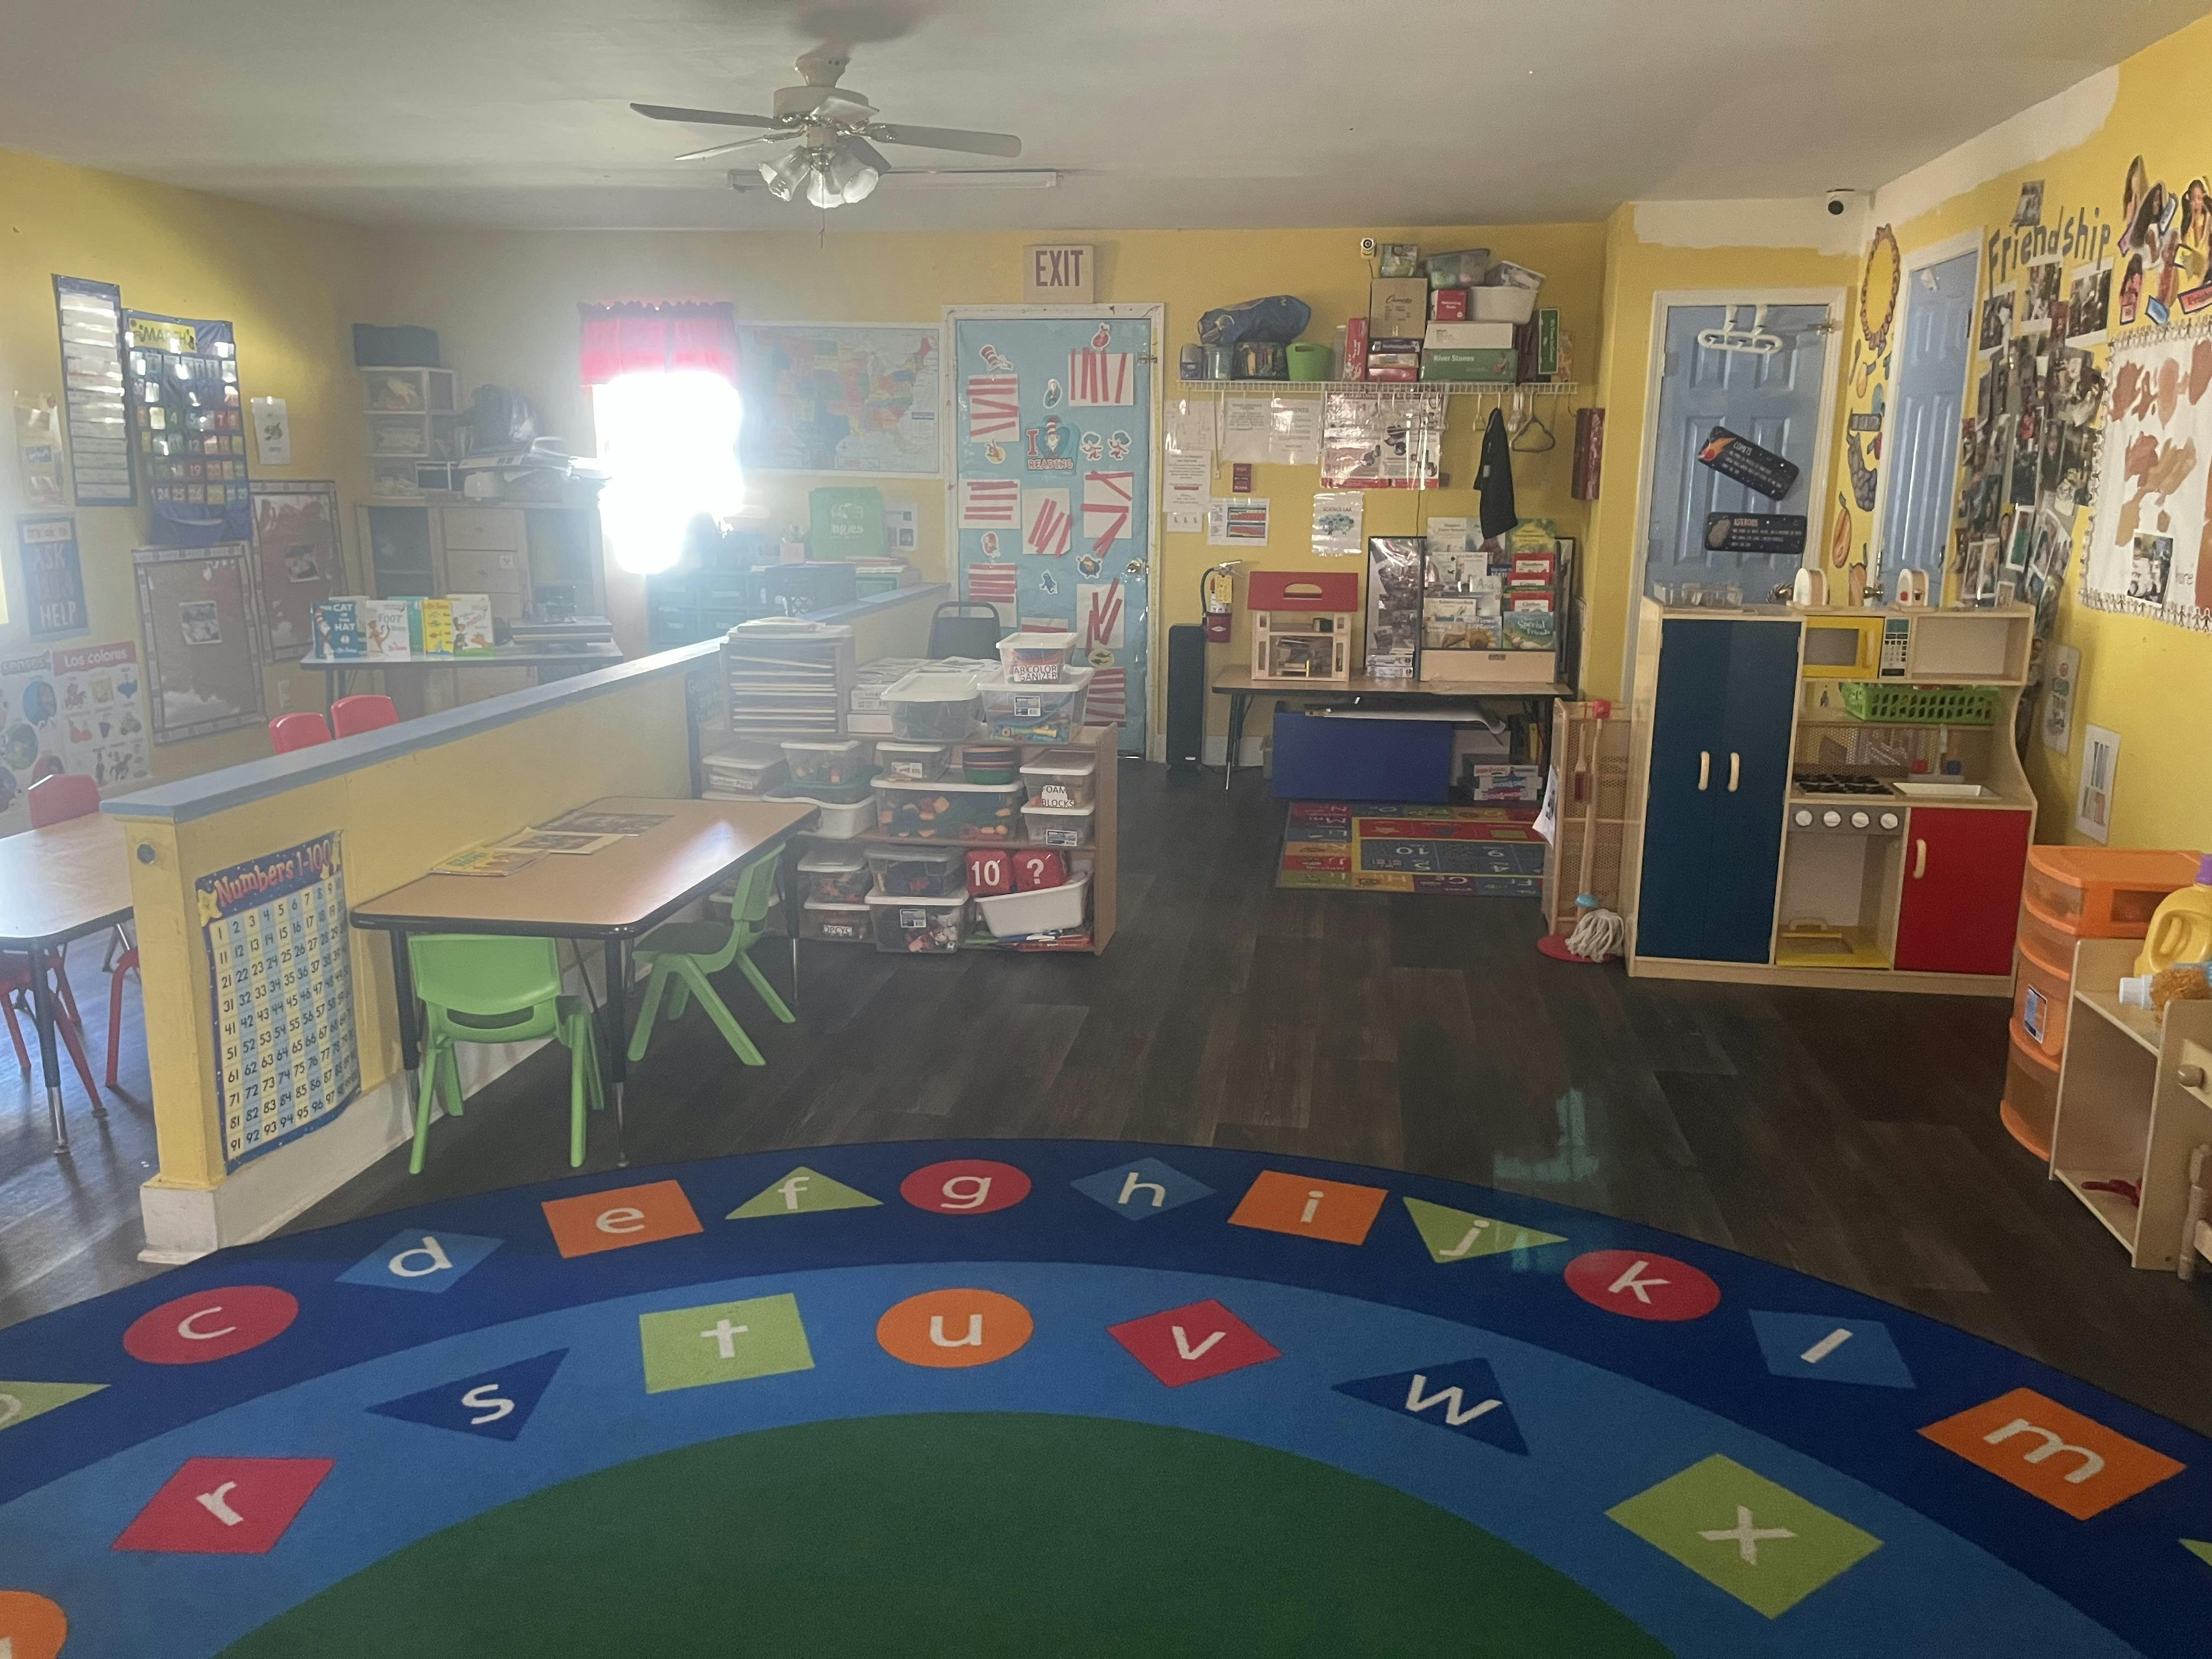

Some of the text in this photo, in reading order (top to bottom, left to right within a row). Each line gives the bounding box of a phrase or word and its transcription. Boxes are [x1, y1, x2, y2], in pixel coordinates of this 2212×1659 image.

[1035, 250, 1084, 286] EXIT
[1989, 205, 2111, 301] Friendship
[1026, 428, 1039, 457] I
[1028, 458, 1074, 470] READING
[40, 600, 76, 629] HELP
[334, 603, 353, 612] CAT
[335, 623, 356, 631] HAT
[64, 648, 127, 668] Los colores
[1027, 665, 1057, 674] COLOR
[1042, 799, 1075, 808] BLOCKS
[215, 839, 332, 907] Numbers 1-100
[971, 859, 1044, 887] 10 ?
[218, 926, 222, 940] 1
[233, 921, 240, 934] 2
[249, 915, 256, 927] 3
[263, 909, 270, 921] 4
[278, 904, 284, 916] 5
[292, 898, 297, 910] 6
[304, 892, 310, 905] 7
[220, 951, 228, 964] 11
[234, 945, 244, 958] 12
[250, 938, 259, 952] 13
[264, 933, 274, 946] 14
[279, 926, 288, 939] 15
[292, 921, 301, 933] 16
[306, 915, 314, 928] 17
[222, 974, 232, 990] 21
[236, 968, 249, 983] 22
[251, 961, 264, 975] 23
[266, 955, 278, 970] 24
[281, 949, 292, 963] 25
[294, 943, 306, 957] 26
[307, 937, 318, 951] 27
[223, 998, 234, 1013] 31
[239, 991, 252, 1006] 32
[255, 984, 267, 999] 33
[270, 978, 281, 992] 34
[284, 972, 295, 986] 35
[297, 966, 308, 980] 36
[311, 960, 320, 974] 37
[225, 1021, 236, 1035] 41
[240, 1014, 253, 1029] 42
[257, 1007, 269, 1022] 43
[272, 1000, 284, 1014] 44
[286, 994, 298, 1008] 45
[300, 988, 311, 1001] 46
[313, 981, 323, 995] 47
[227, 1045, 237, 1060] 51
[242, 1038, 256, 1054] 52
[259, 1031, 272, 1046] 53
[274, 1024, 286, 1039] 54
[289, 1016, 300, 1032] 55
[303, 1010, 314, 1025] 56
[316, 1003, 325, 1018] 57
[228, 1069, 239, 1083] 61
[244, 1062, 257, 1076] 62
[261, 1053, 274, 1068] 63
[276, 1046, 289, 1062] 64
[292, 1039, 302, 1054] 65
[305, 1032, 317, 1047] 66
[319, 1025, 328, 1040] 67
[229, 1092, 240, 1107] 71
[245, 1084, 258, 1100] 72
[262, 1076, 275, 1092] 73
[278, 1070, 291, 1085] 74
[293, 1062, 305, 1077] 75
[308, 1056, 318, 1070] 76
[320, 1047, 330, 1063] 77
[230, 1115, 240, 1130] 81
[246, 1107, 259, 1121] 82
[263, 1098, 276, 1114] 83
[296, 1084, 307, 1098] 85
[310, 1077, 321, 1091] 86
[324, 1068, 332, 1084] 87
[230, 1090, 335, 1152] 91 92 93 94 95 96 97
[778, 1176, 810, 1210] f
[940, 1176, 992, 1209] g
[1118, 1172, 1166, 1207] h
[1300, 1190, 1324, 1223] i
[596, 1207, 645, 1233] e
[1438, 1219, 1490, 1257] j
[388, 1237, 454, 1278] d
[1607, 1261, 1671, 1305] k
[178, 1306, 237, 1340] c
[700, 1318, 748, 1359] t
[929, 1313, 983, 1347] u
[1171, 1325, 1226, 1360] v
[461, 1384, 516, 1425] s
[1405, 1374, 1503, 1426] w
[1983, 1418, 2106, 1484] m
[196, 1481, 244, 1527] r
[1696, 1505, 1798, 1565] x
